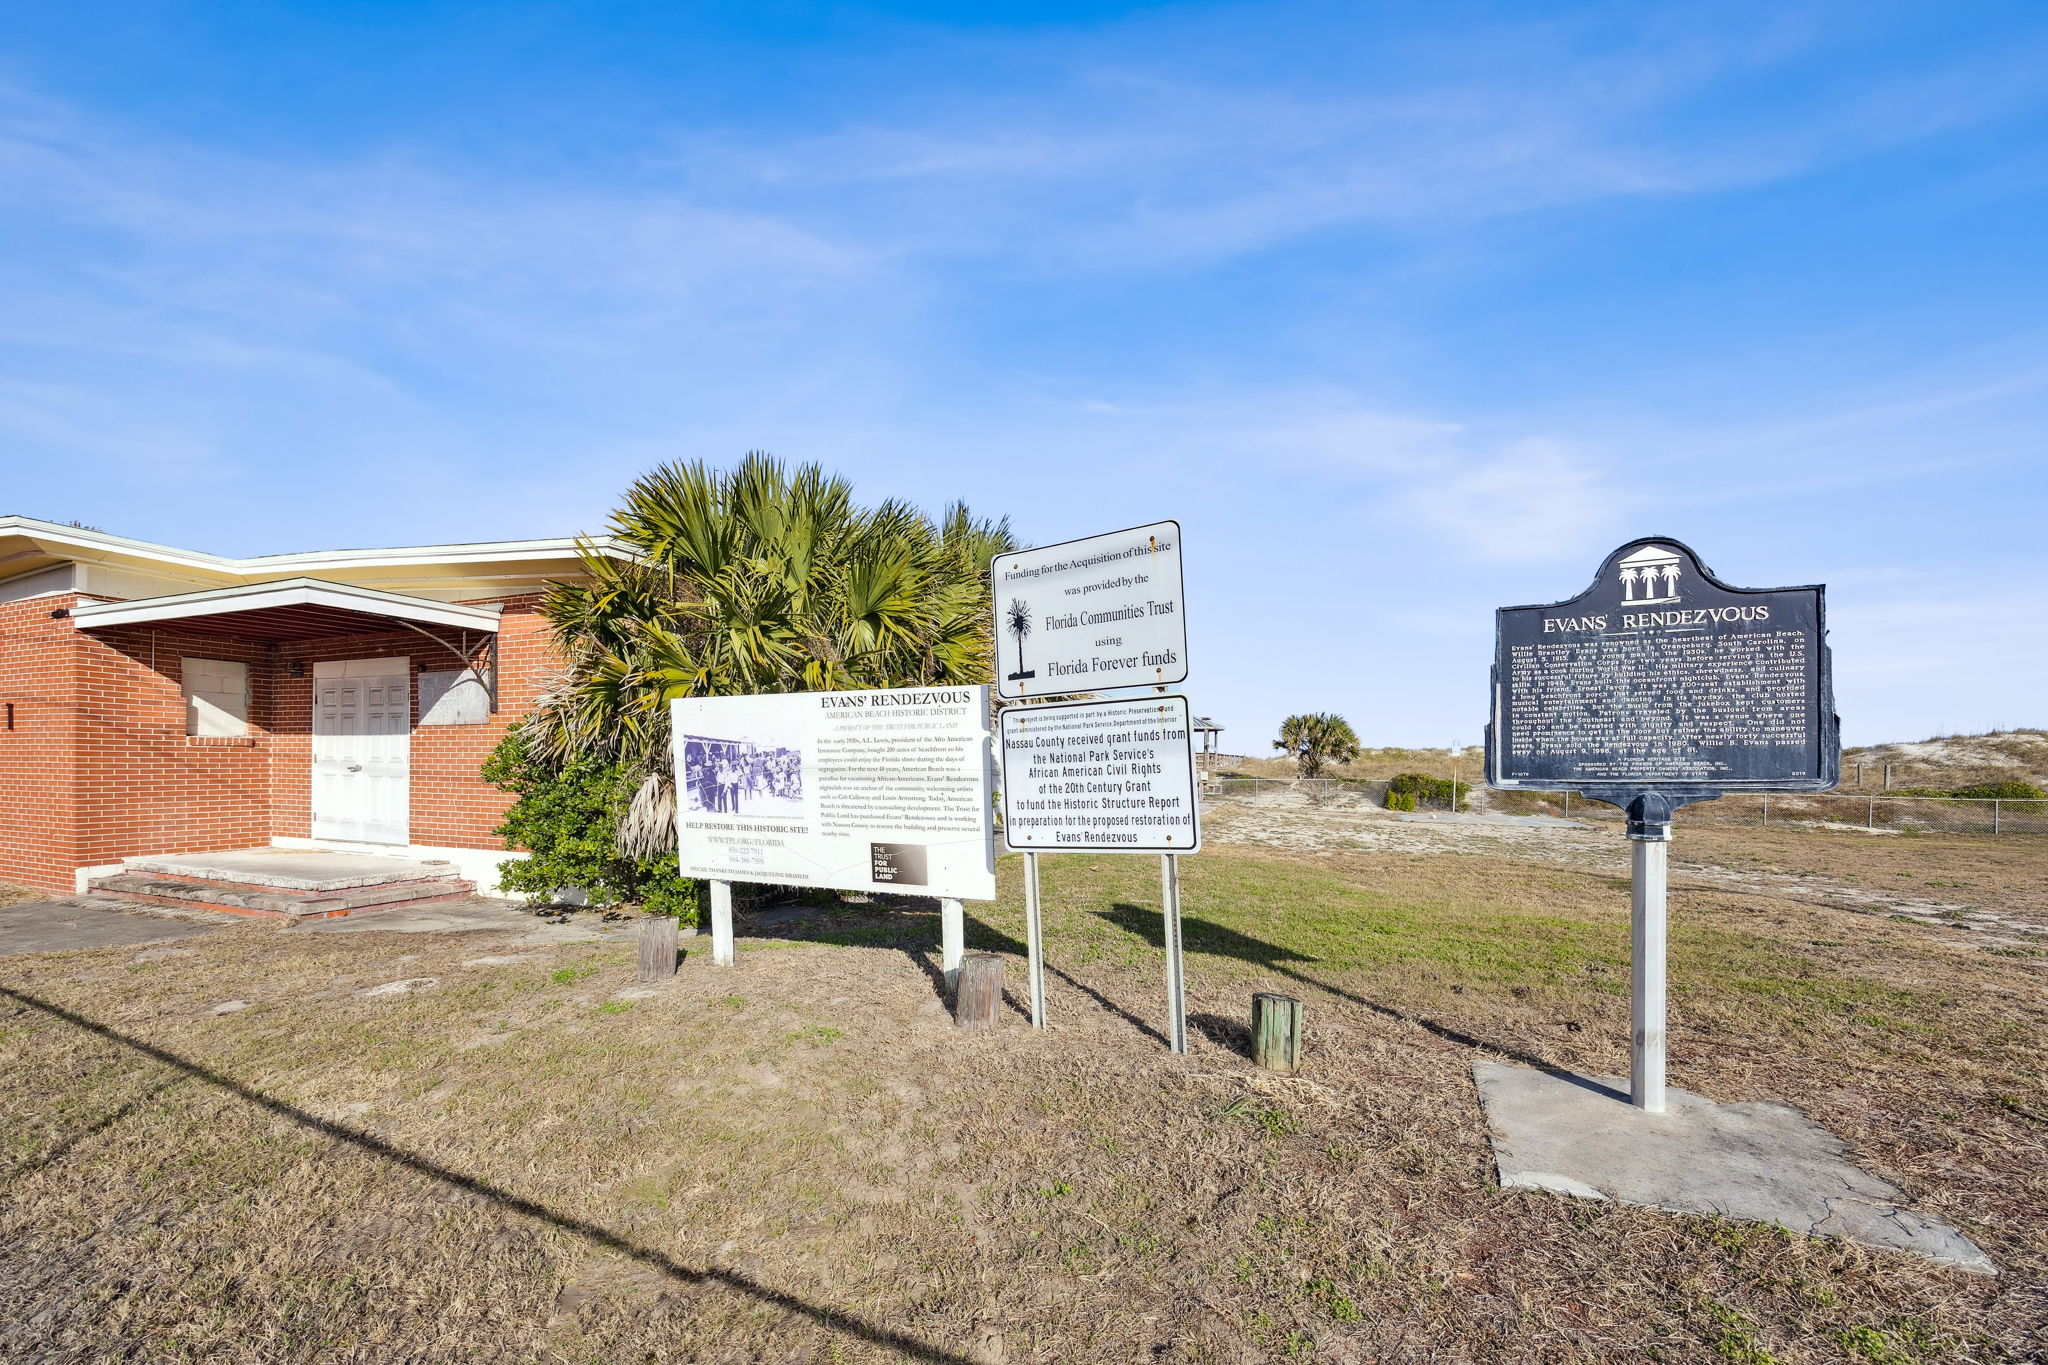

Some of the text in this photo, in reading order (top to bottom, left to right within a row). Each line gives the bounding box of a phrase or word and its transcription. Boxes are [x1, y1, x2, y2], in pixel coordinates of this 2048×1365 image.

[1005, 542, 1171, 580] Funding for the Acquisition of this site
[1064, 574, 1149, 596] was provided by the
[1046, 600, 1174, 630] Florida Communities Trust
[1543, 606, 1769, 632] EVANS' RENDEZVOUS
[1095, 637, 1122, 647] using
[1048, 649, 1176, 676] Florida Forever funds
[871, 691, 970, 706] RENDEZVOUS
[825, 711, 863, 719] AMERICAN
[892, 709, 928, 717] HISTORIC
[931, 708, 967, 716] DISTRICT
[1114, 719, 1141, 727] Department
[1006, 729, 1185, 749] Nassau County received grant funds from
[1033, 749, 1154, 764] the National Park Service's
[1029, 763, 1161, 778] African American Civil Rights
[1039, 780, 1151, 795] of the 20th Century Grant
[1017, 796, 1180, 812] to fund the Historic Structure Report
[705, 822, 735, 831] RESTORE
[754, 825, 788, 833] HISTORIC
[1009, 814, 1191, 828] in preparation for the proposed restoration of
[1085, 831, 1138, 842] Rendezvous
